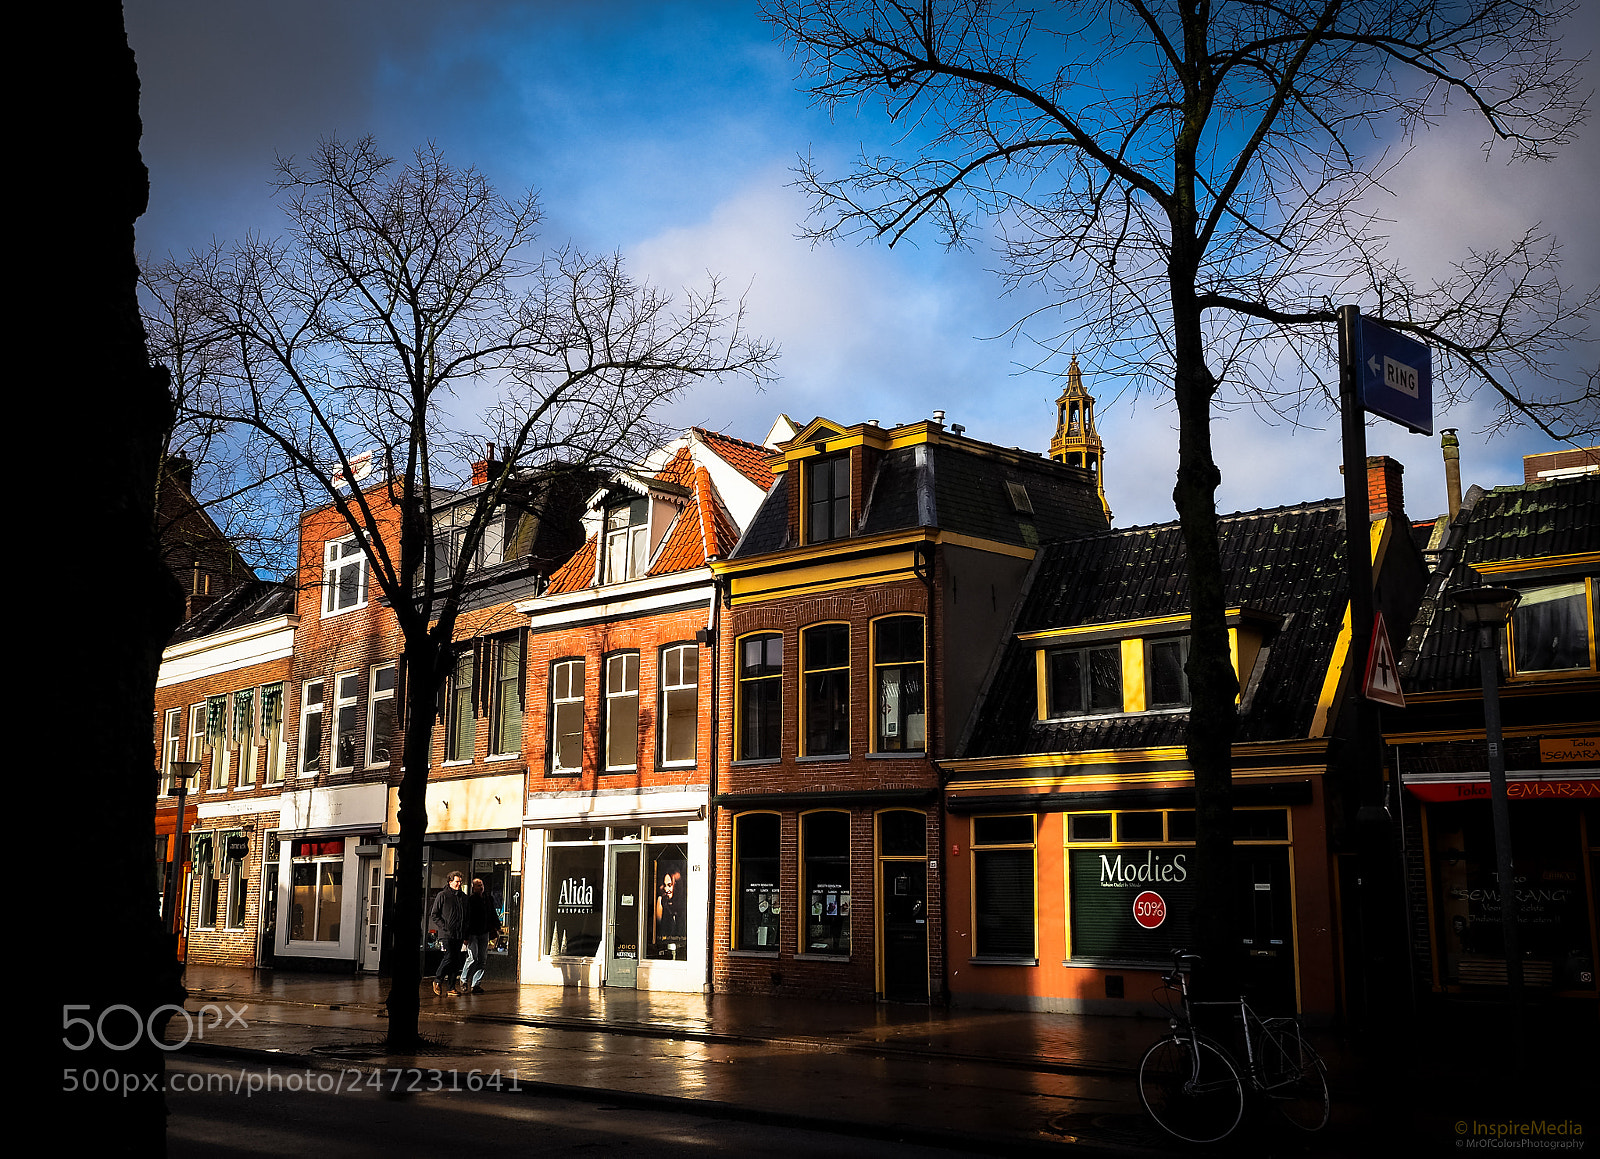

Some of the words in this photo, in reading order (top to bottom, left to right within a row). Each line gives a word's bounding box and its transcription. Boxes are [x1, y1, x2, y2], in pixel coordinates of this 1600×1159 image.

[1387, 363, 1415, 390] RING
[1571, 739, 1595, 747] Toko
[1455, 785, 1487, 797] Toko
[1099, 850, 1187, 882] ModieS
[558, 877, 593, 905] Alida
[1452, 887, 1573, 902] "SEMRANG"
[1137, 901, 1163, 917] 50%
